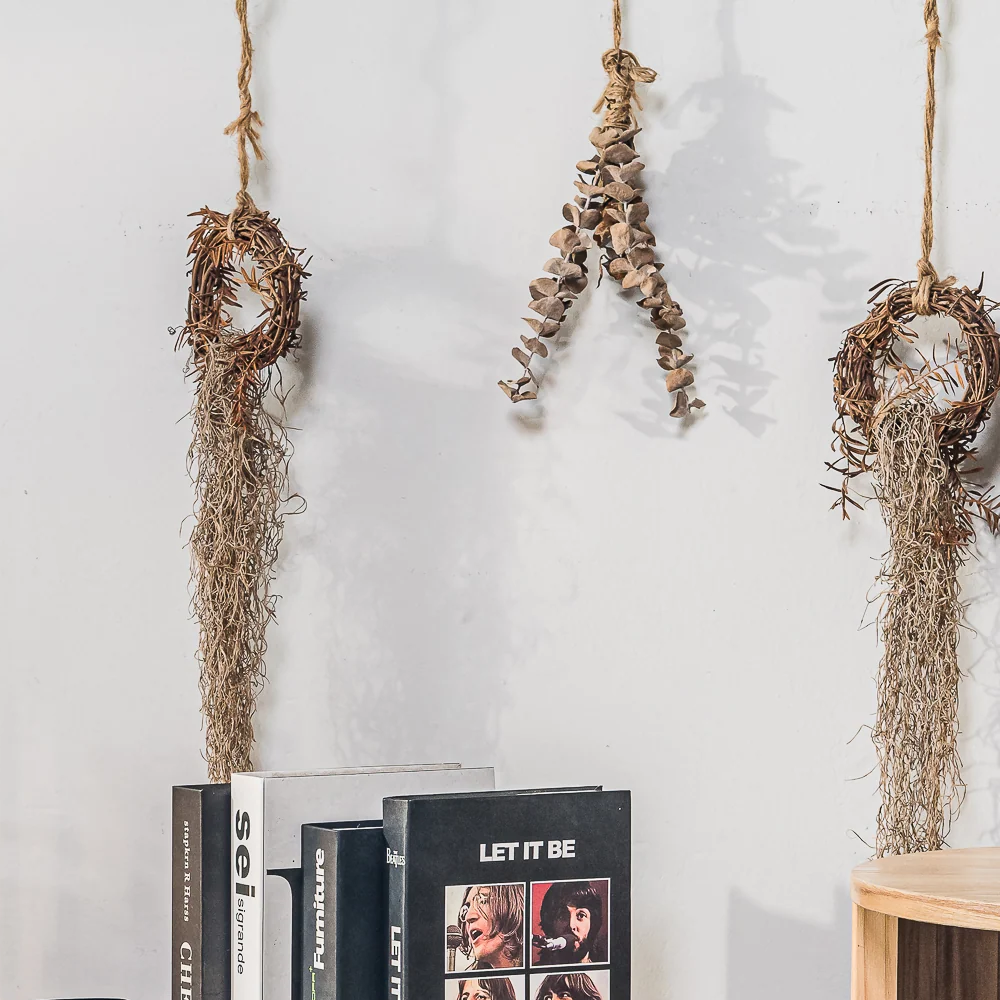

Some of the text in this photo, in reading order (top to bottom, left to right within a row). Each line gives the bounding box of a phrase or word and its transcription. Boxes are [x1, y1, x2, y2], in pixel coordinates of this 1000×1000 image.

[386, 847, 406, 869] BEATLES
[479, 839, 576, 863] LET IT BE
[235, 809, 256, 975] sei sigrande
[313, 848, 325, 970] Furniture
[390, 925, 402, 973] LET
